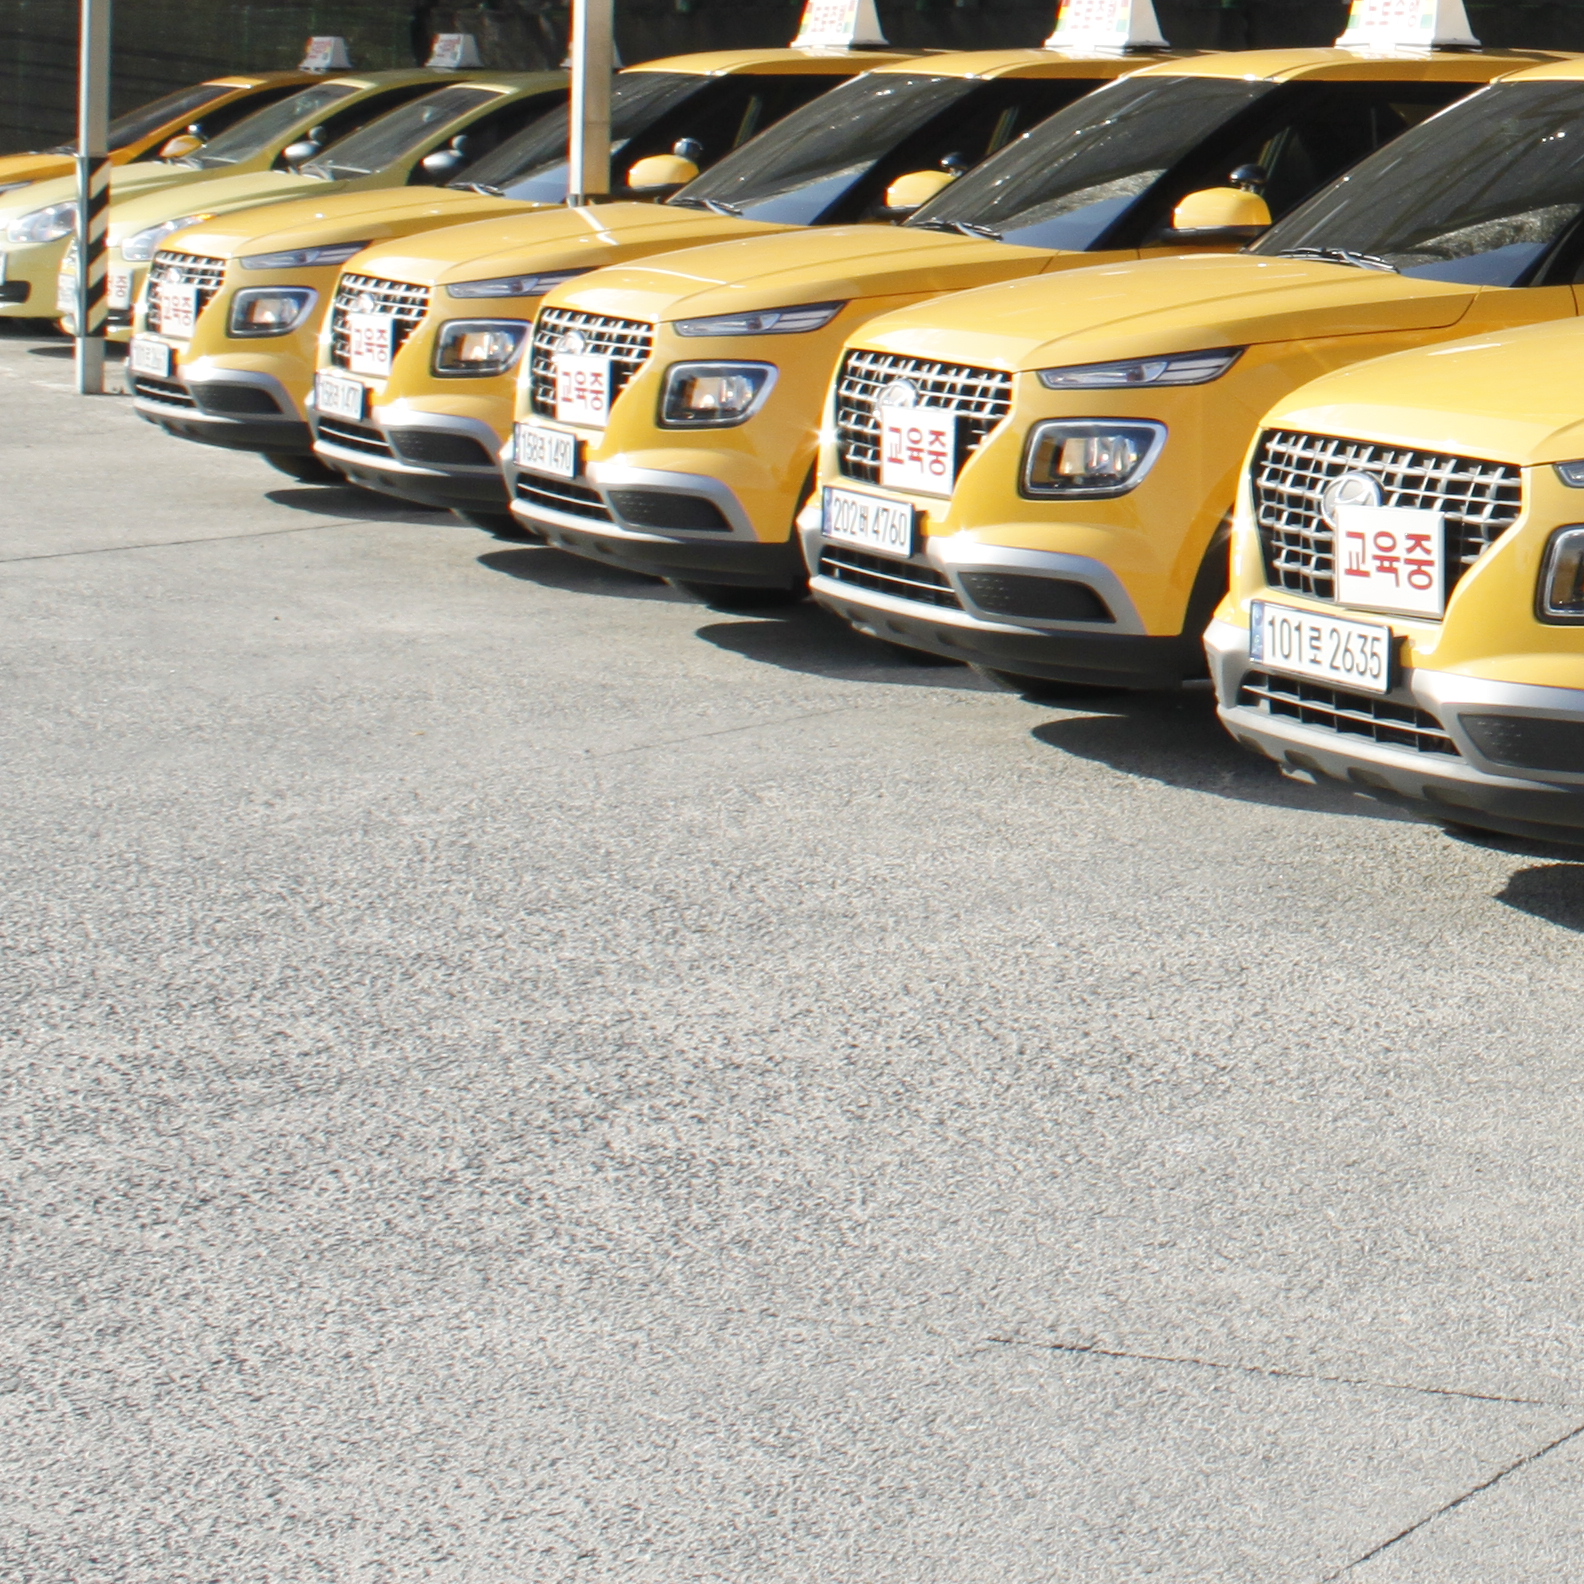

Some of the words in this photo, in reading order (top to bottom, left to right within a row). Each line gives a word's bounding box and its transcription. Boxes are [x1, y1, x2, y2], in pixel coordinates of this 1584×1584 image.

[561, 371, 605, 411] 교육중
[886, 426, 948, 477] 교육중
[1344, 530, 1435, 591] 교육중
[1329, 627, 1383, 680] 2635
